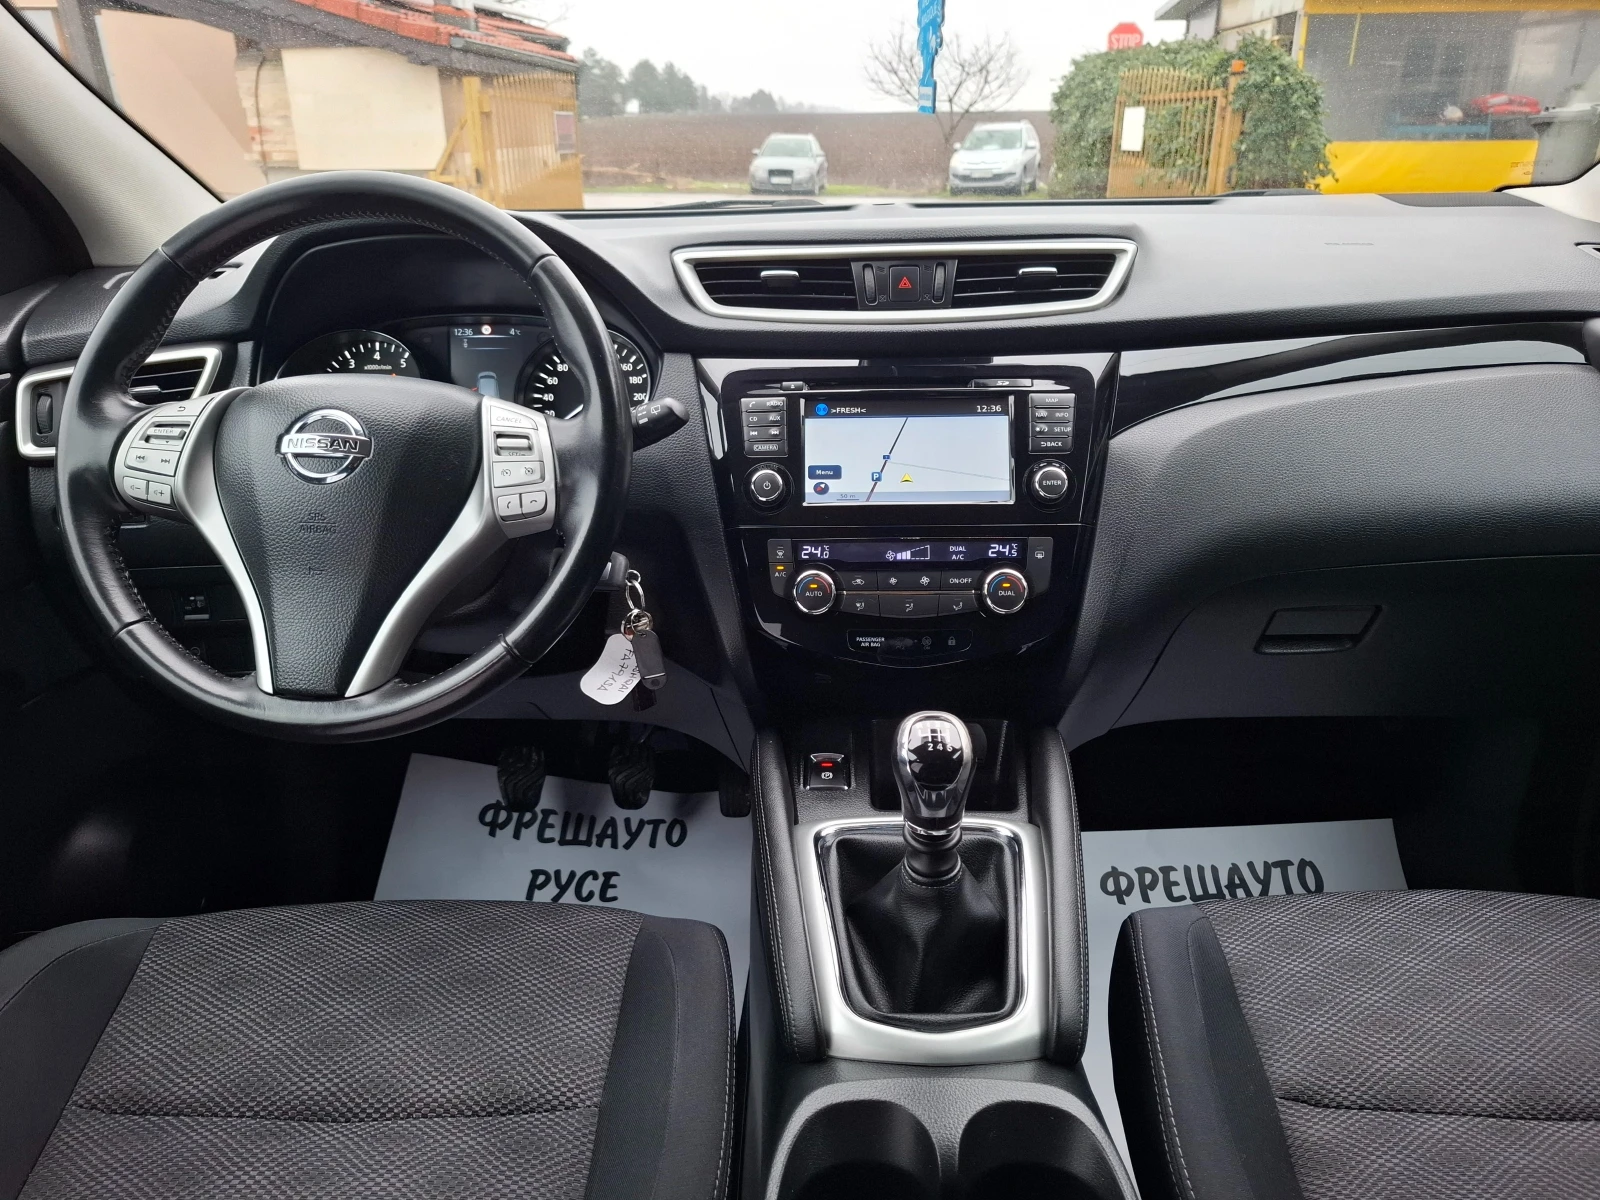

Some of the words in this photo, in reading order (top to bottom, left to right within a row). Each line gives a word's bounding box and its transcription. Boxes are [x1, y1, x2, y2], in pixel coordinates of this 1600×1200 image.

[1110, 33, 1141, 49] STOP
[454, 328, 473, 336] 12:36
[373, 352, 380, 360] 4
[349, 360, 355, 368] 3
[400, 359, 406, 367] 5
[629, 376, 642, 384] 180
[287, 437, 359, 451] NISSAN
[308, 513, 326, 521] SRS
[300, 525, 337, 533] AIRBAG
[927, 743, 933, 751] 2
[937, 743, 943, 751] 4
[947, 743, 953, 752] 6
[478, 800, 688, 850] ФРЕШАУТО
[525, 868, 621, 902] РУСЕ
[1100, 858, 1325, 905] ФРЕШАУТО
